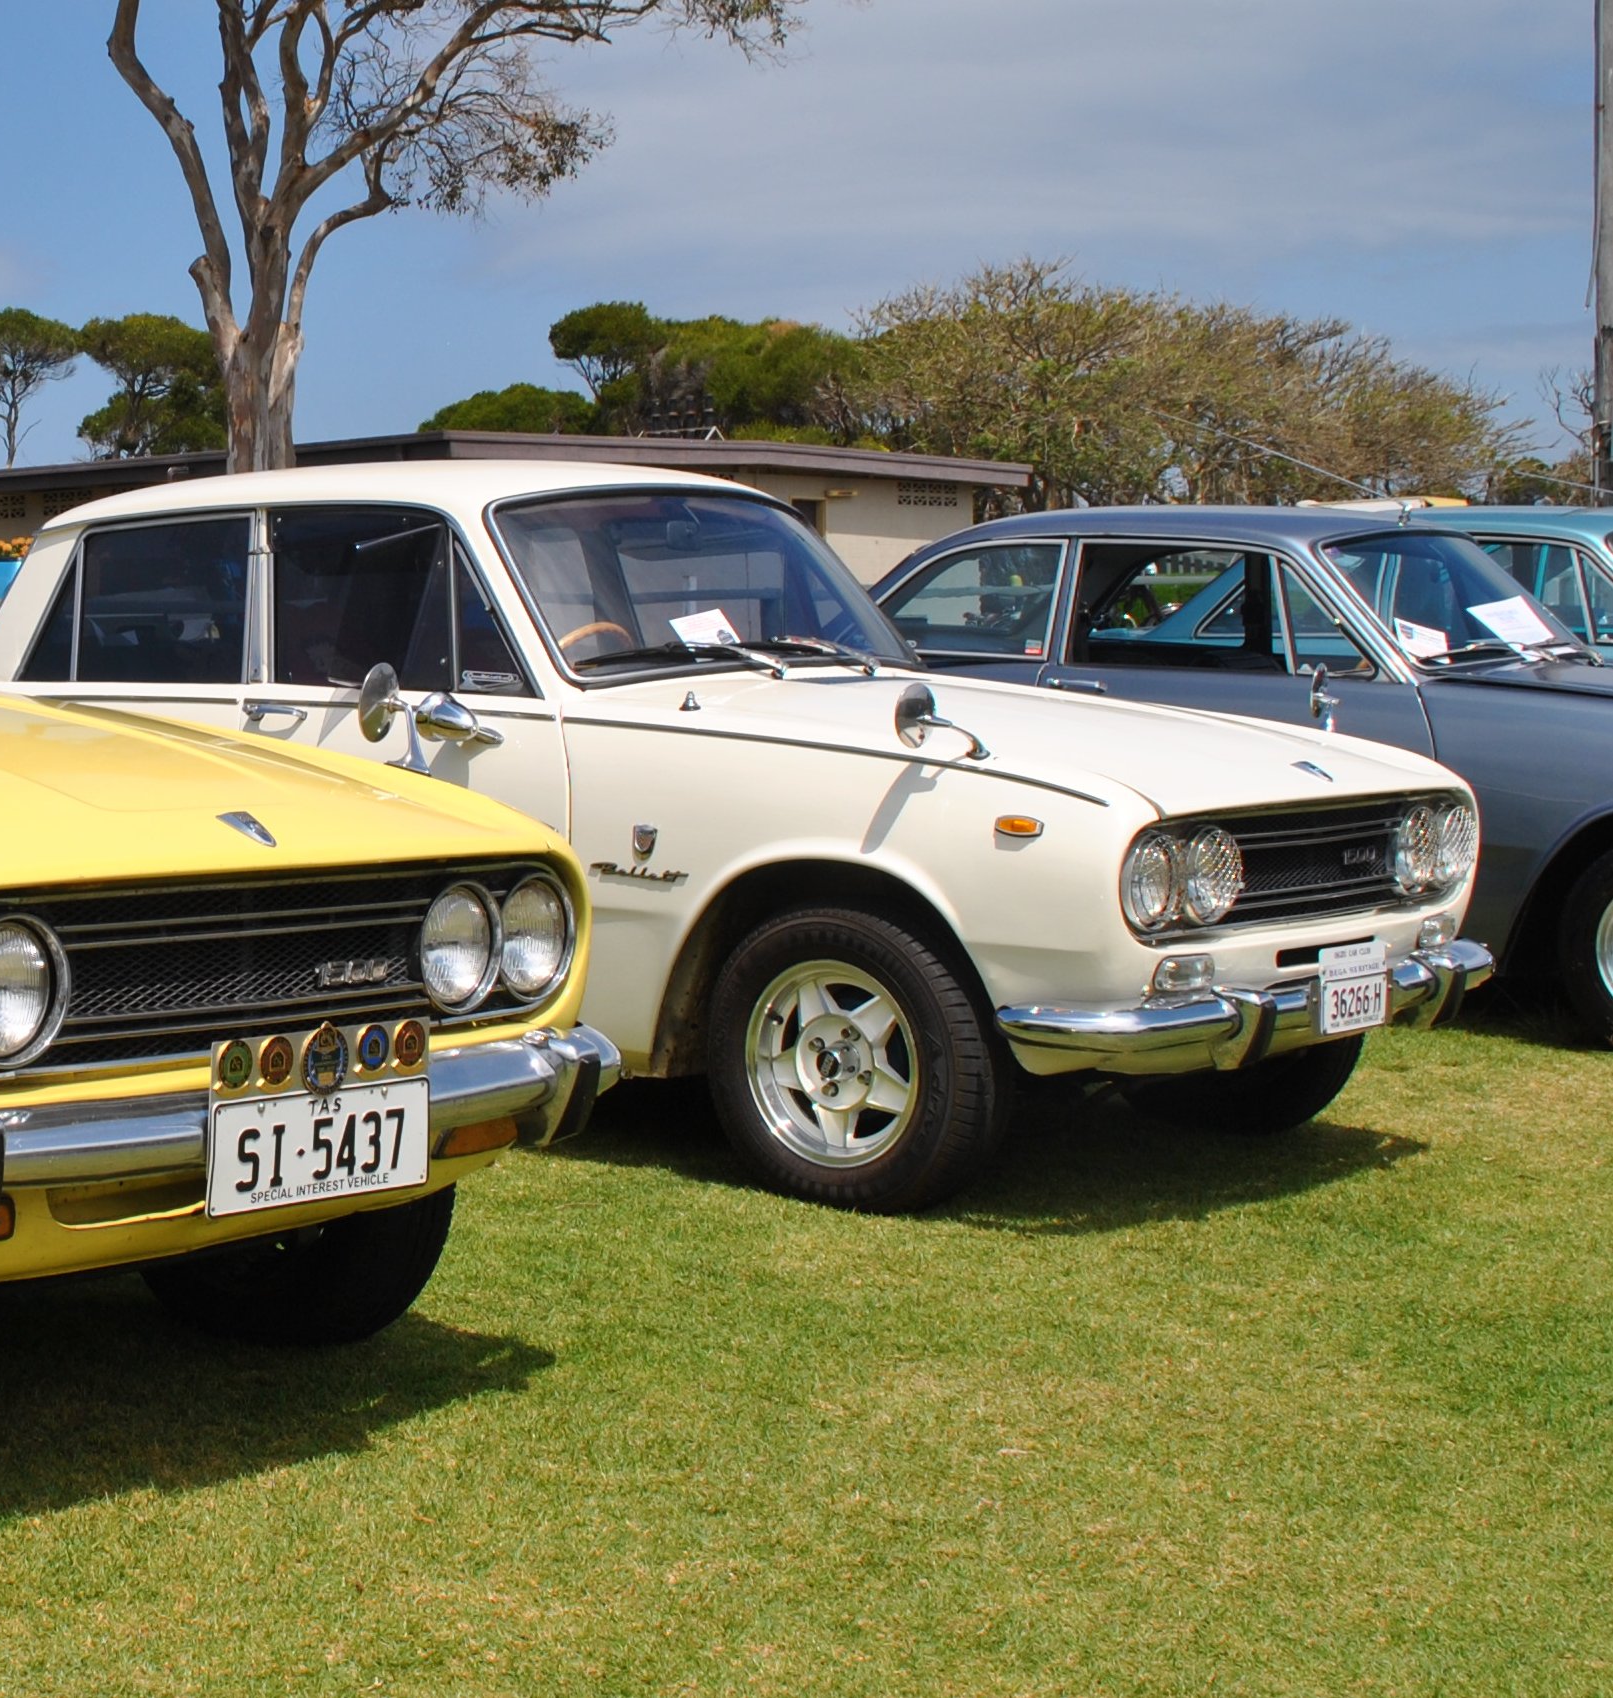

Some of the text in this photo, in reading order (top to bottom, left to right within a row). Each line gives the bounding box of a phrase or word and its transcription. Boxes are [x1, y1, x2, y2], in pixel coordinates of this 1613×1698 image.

[309, 1097, 342, 1116] TAS
[251, 1172, 389, 1204] SPECIAL INTEREST VEHICLE
